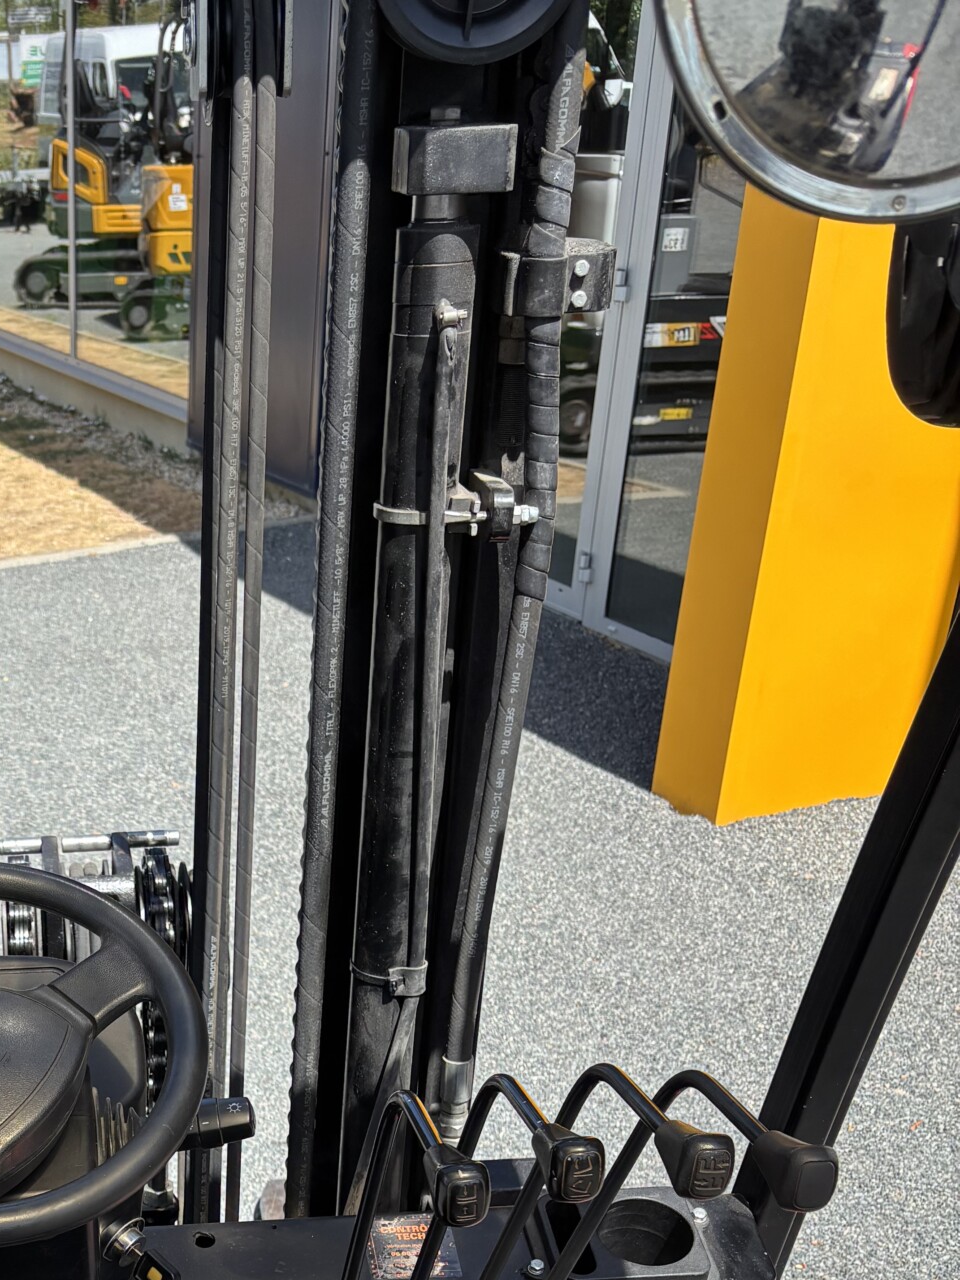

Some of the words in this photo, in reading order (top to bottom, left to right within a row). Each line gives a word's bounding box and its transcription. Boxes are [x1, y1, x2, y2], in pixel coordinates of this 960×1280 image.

[243, 11, 251, 86] ALFAGOMMA
[554, 61, 574, 154] ALFAGOMMA
[348, 297, 357, 329] EN857
[347, 333, 356, 377] exceeds
[343, 392, 353, 417] PSI)
[341, 421, 350, 452] (4000
[339, 477, 348, 490] 28
[518, 612, 530, 639] EN857
[328, 656, 338, 699] FLEXOPAK
[325, 711, 335, 736] ITALY
[500, 739, 510, 755] R16
[321, 750, 332, 818] ALFAGOMMA
